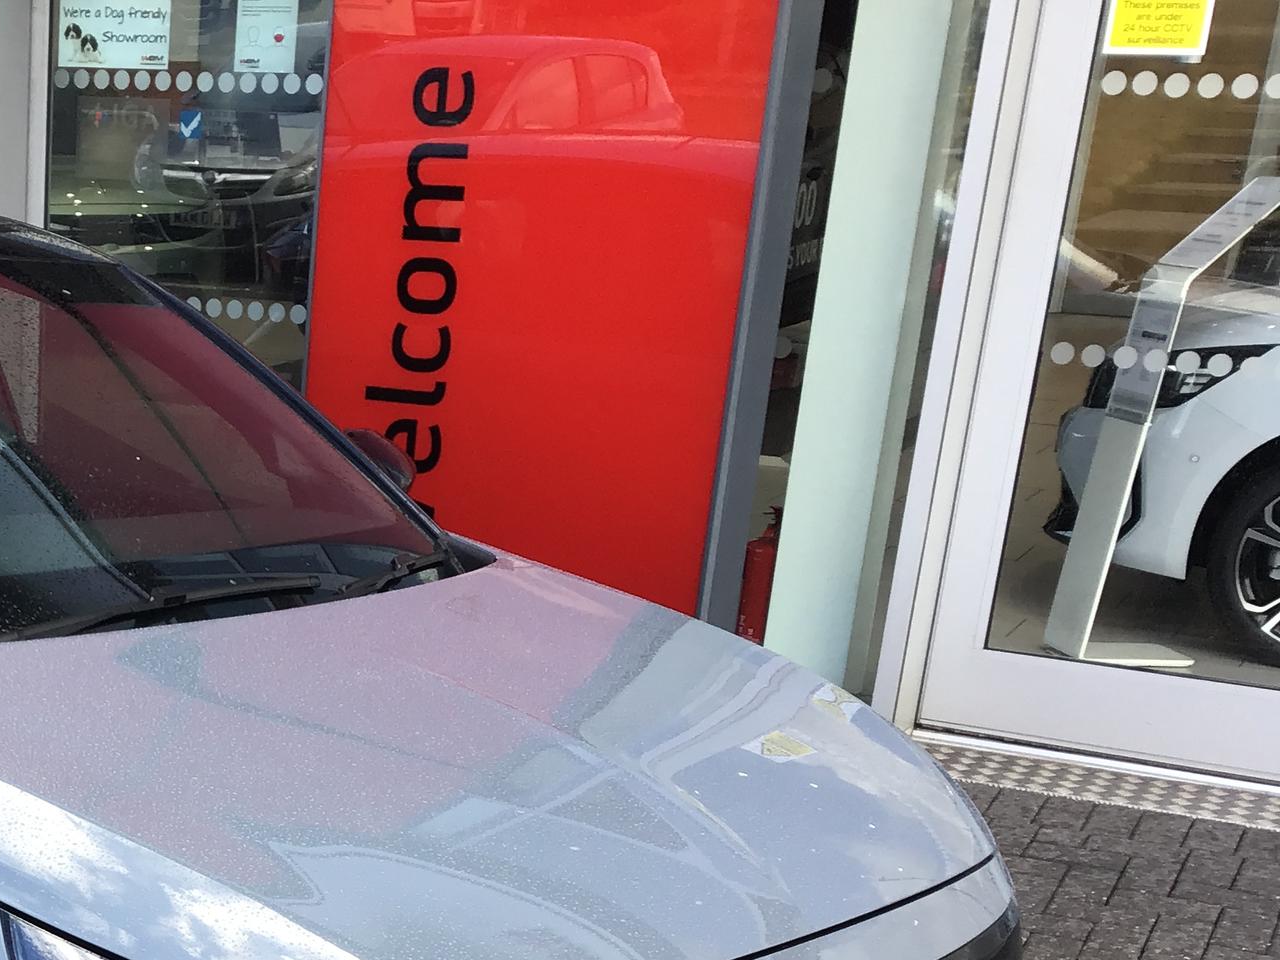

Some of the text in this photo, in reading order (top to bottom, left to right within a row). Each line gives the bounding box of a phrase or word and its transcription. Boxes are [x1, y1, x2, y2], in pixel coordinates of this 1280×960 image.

[1123, 0, 1200, 10] These premises
[63, 6, 167, 24] We're a Dog friendly
[1154, 13, 1184, 21] under
[1123, 24, 1193, 32] 24 hour CCTV
[102, 31, 167, 43] Showroom
[365, 66, 476, 522] elcome
